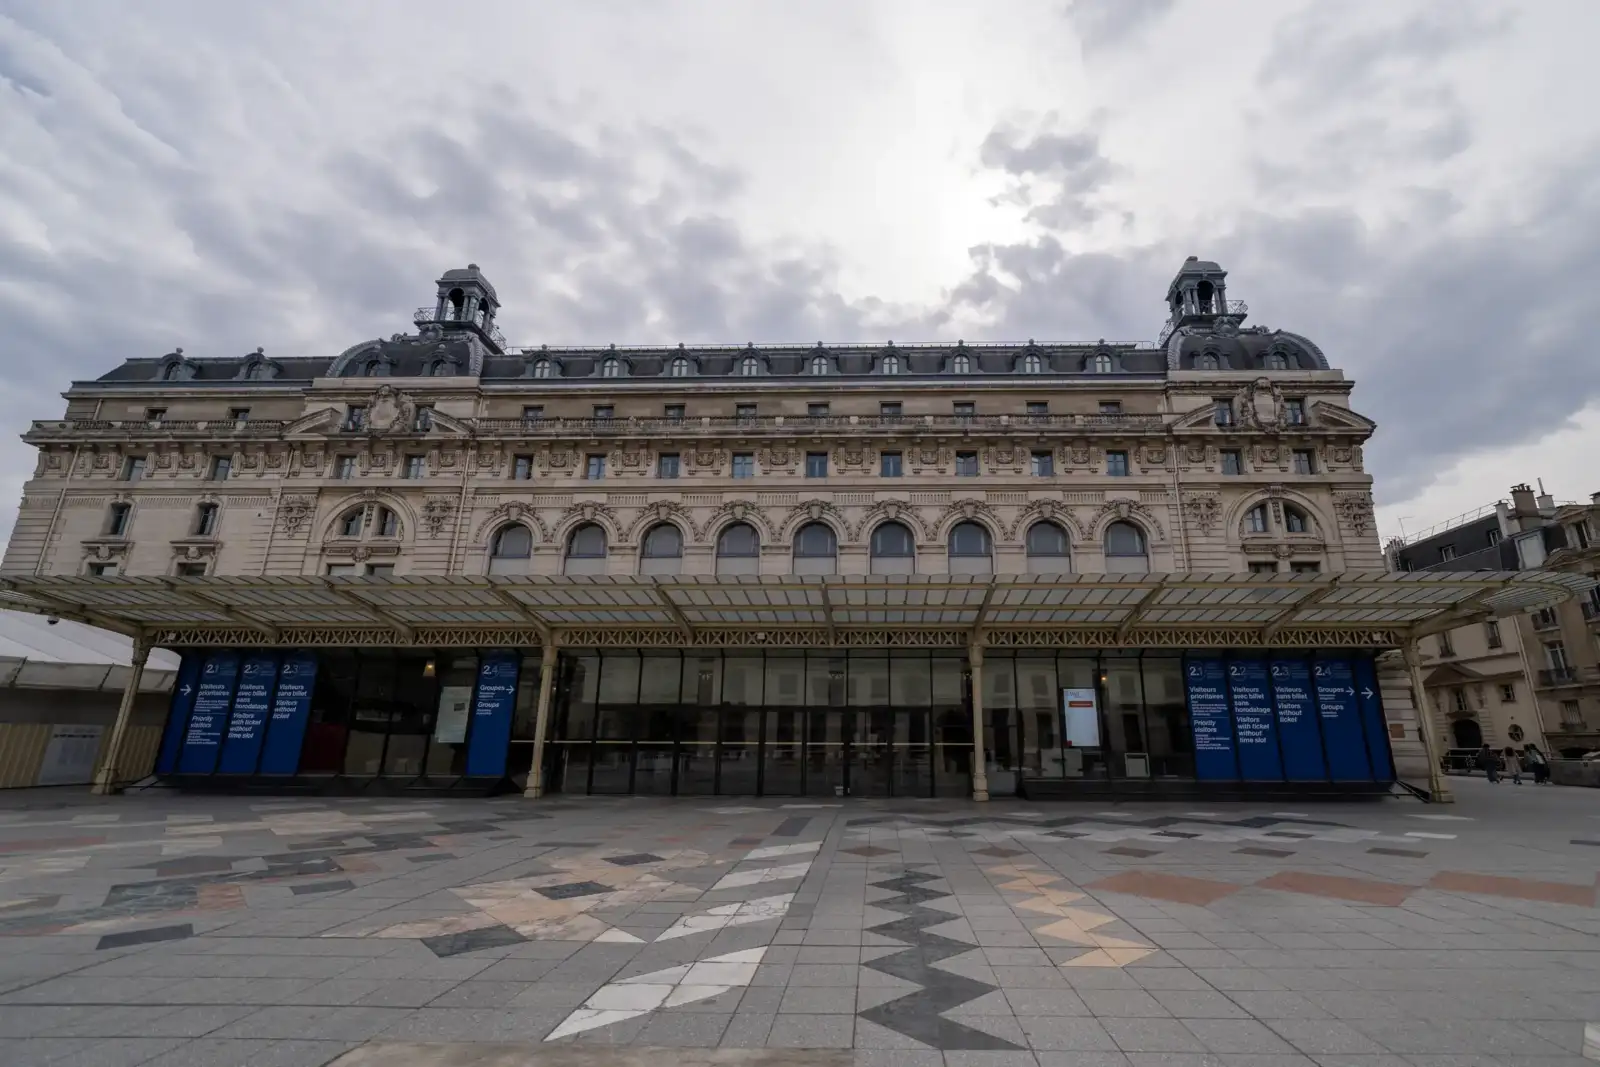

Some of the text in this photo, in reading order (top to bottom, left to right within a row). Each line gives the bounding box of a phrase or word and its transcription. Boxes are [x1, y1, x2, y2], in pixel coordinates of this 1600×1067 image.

[244, 664, 260, 674] 2.2
[283, 664, 298, 674] 2.3
[483, 665, 498, 674] 2.4
[1190, 666, 1202, 676] 2.1
[1231, 666, 1246, 676] 2.2
[1273, 666, 1289, 676] 2.3
[1315, 666, 1331, 676] 2.4
